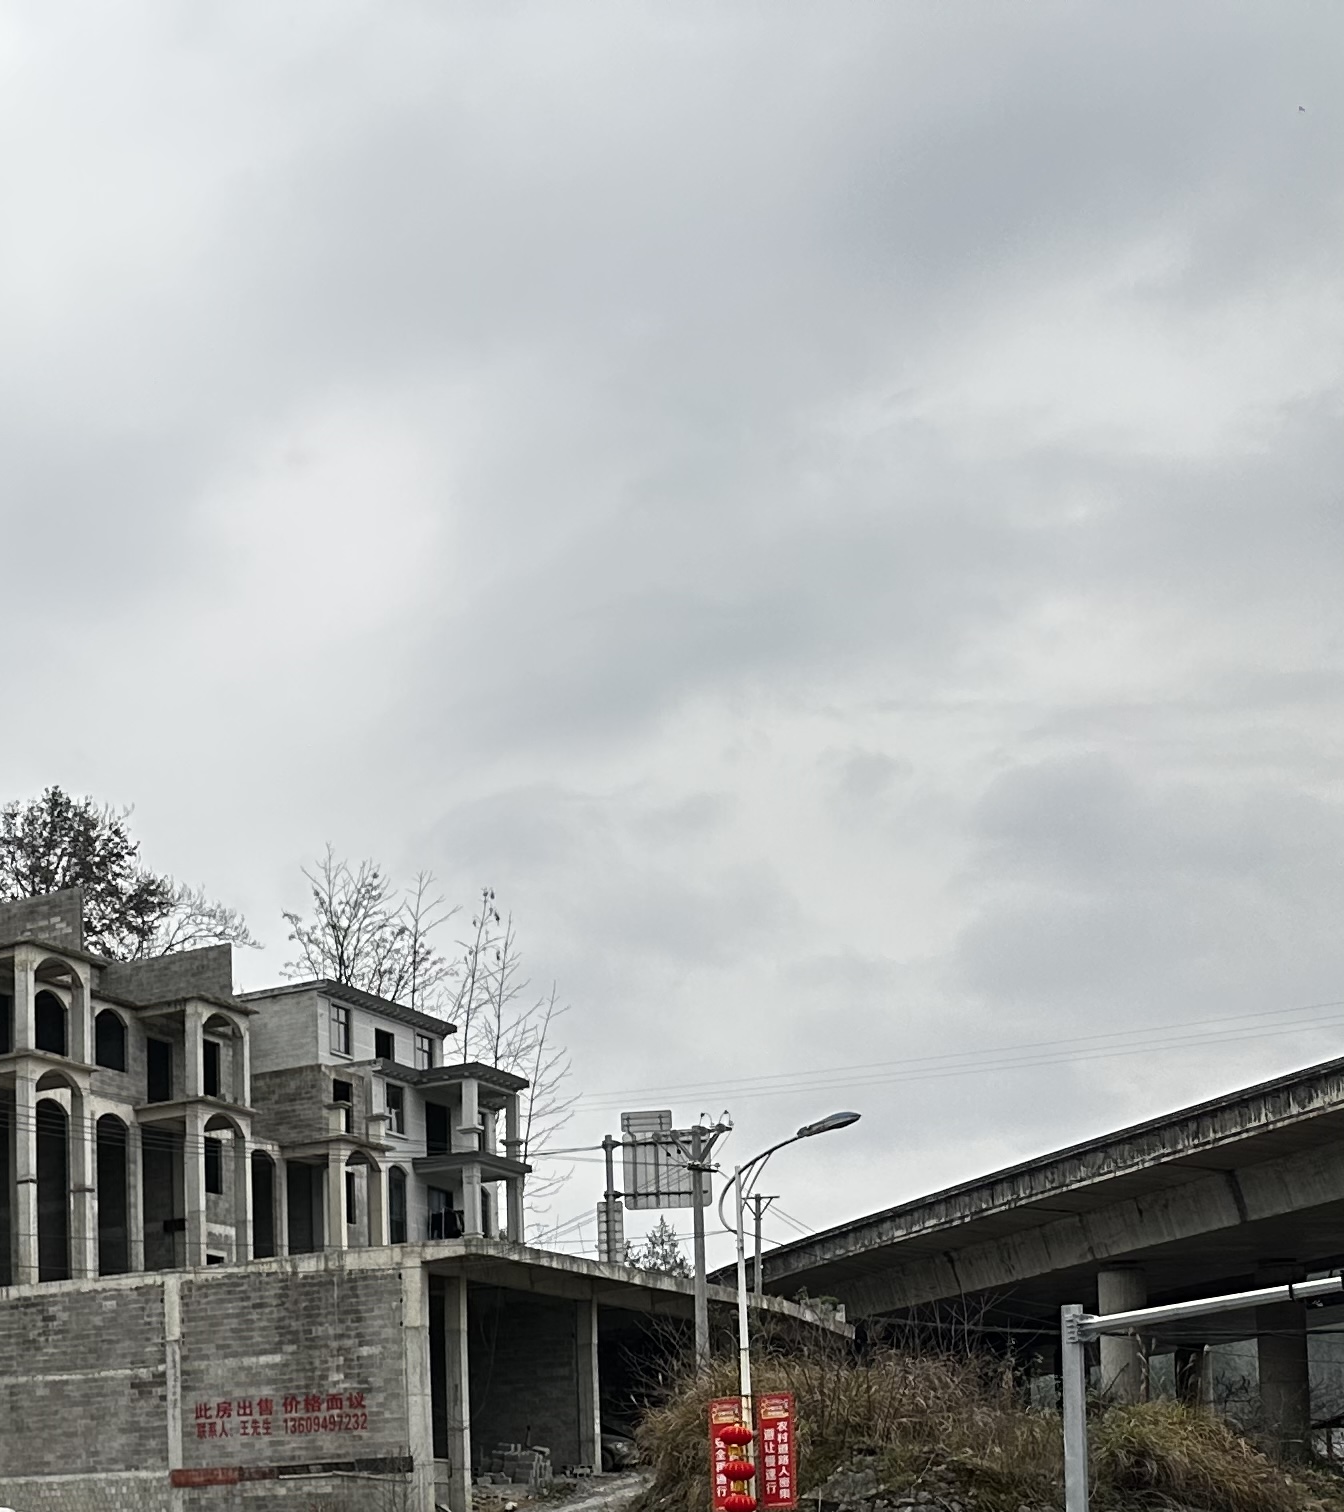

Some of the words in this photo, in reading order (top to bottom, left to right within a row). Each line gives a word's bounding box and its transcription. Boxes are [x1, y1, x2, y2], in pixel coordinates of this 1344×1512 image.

[195, 1397, 274, 1420] 此房出售
[282, 1391, 367, 1415] 价格面议
[283, 1412, 368, 1435] 13609497232
